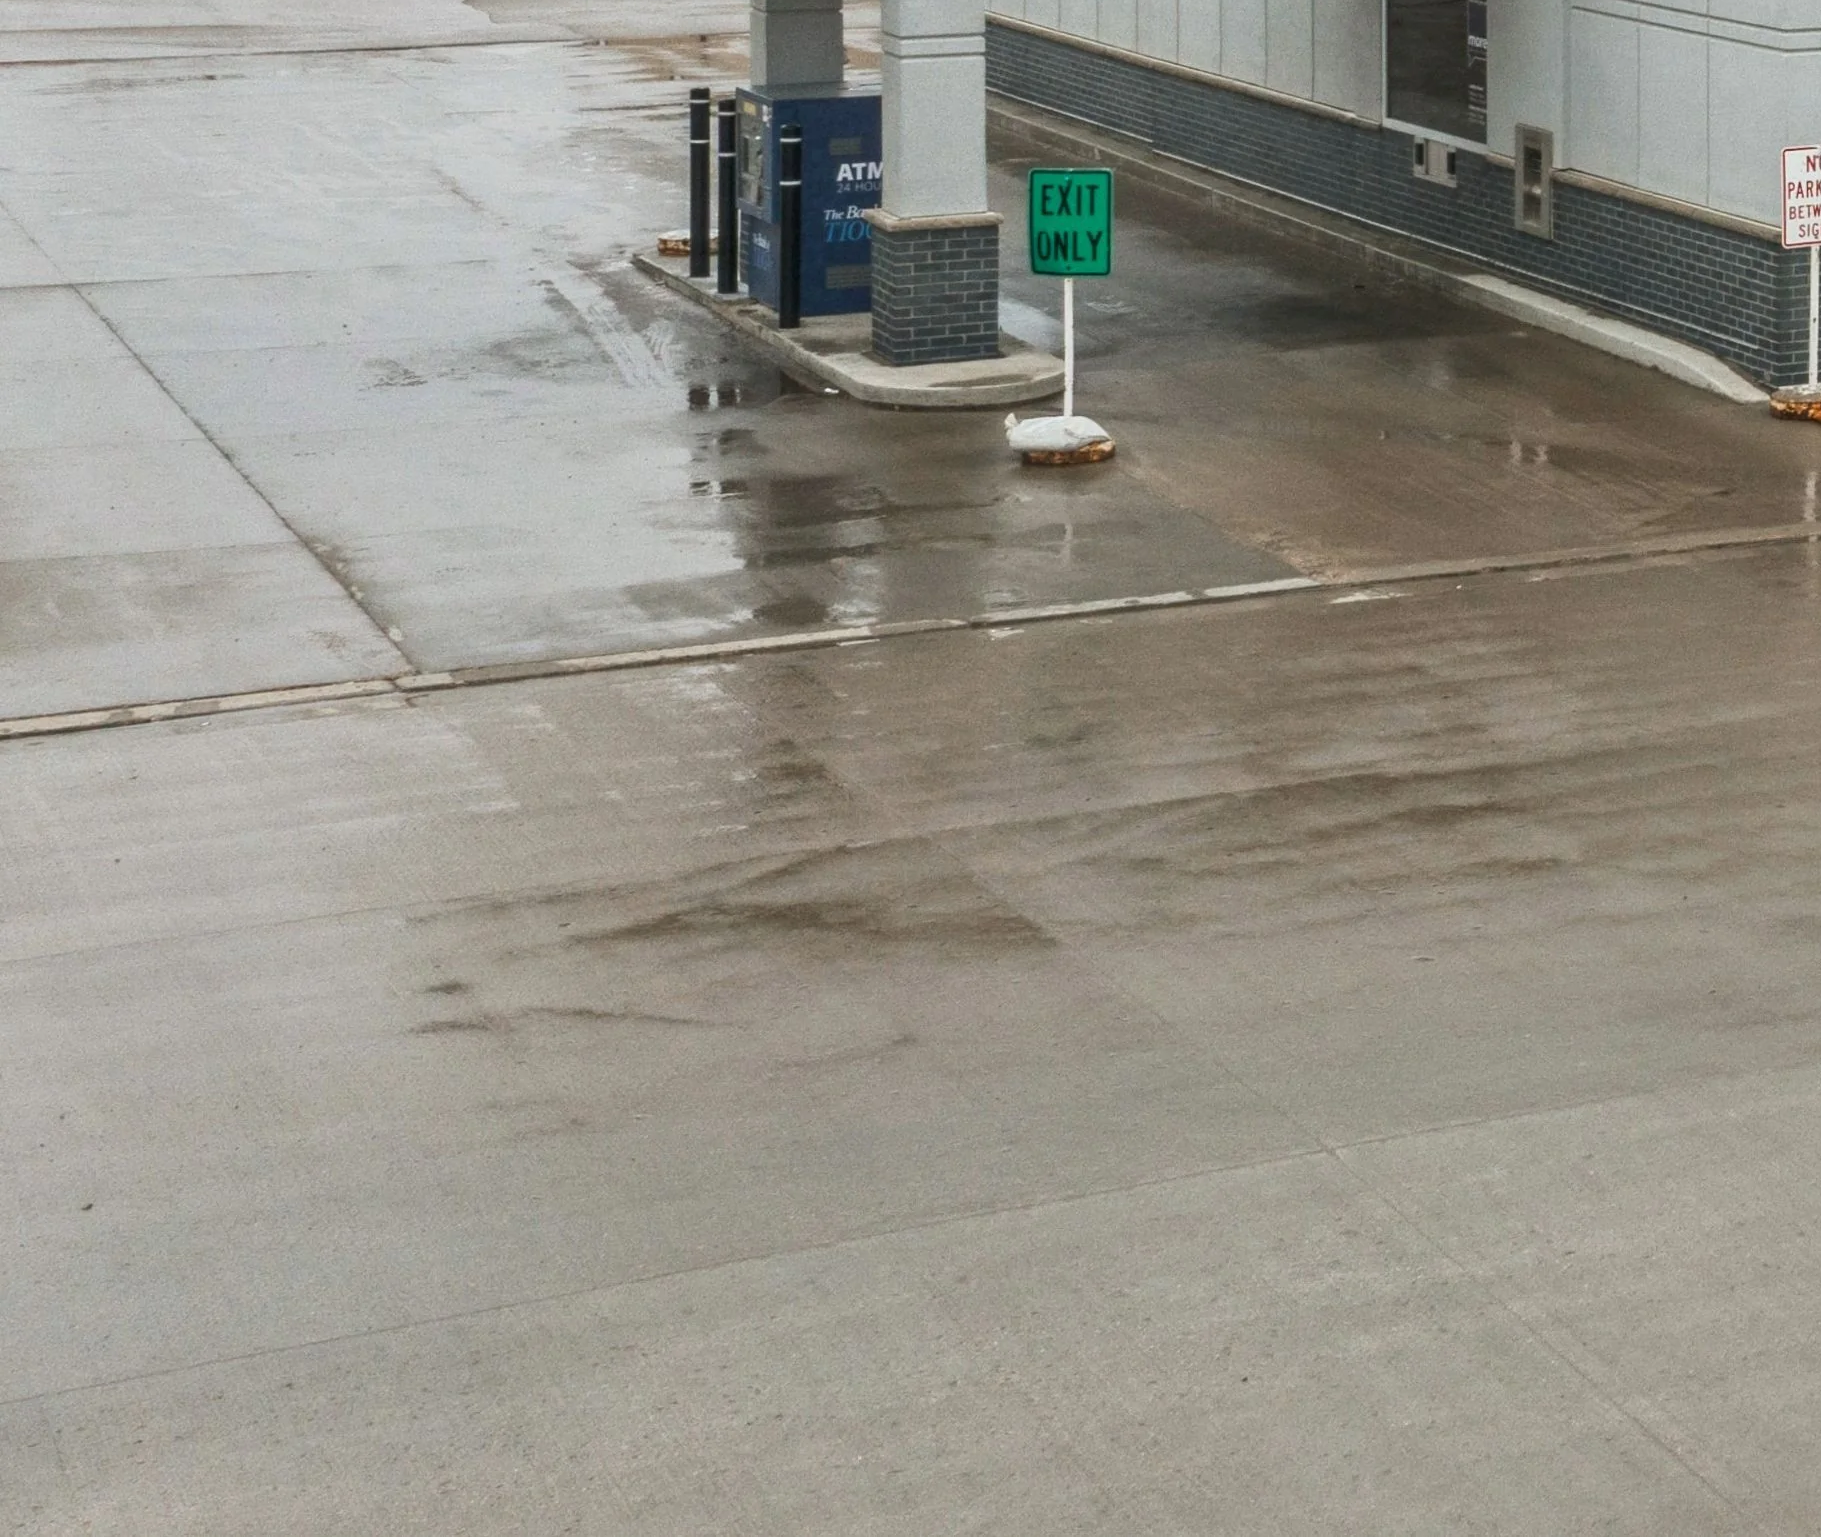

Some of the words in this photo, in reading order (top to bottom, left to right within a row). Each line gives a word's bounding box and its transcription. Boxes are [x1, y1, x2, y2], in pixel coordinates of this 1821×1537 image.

[836, 162, 883, 182] ATM
[837, 183, 851, 193] 24
[1041, 183, 1100, 216] EXIT
[824, 209, 845, 220] The
[1037, 230, 1103, 261] ONLY
